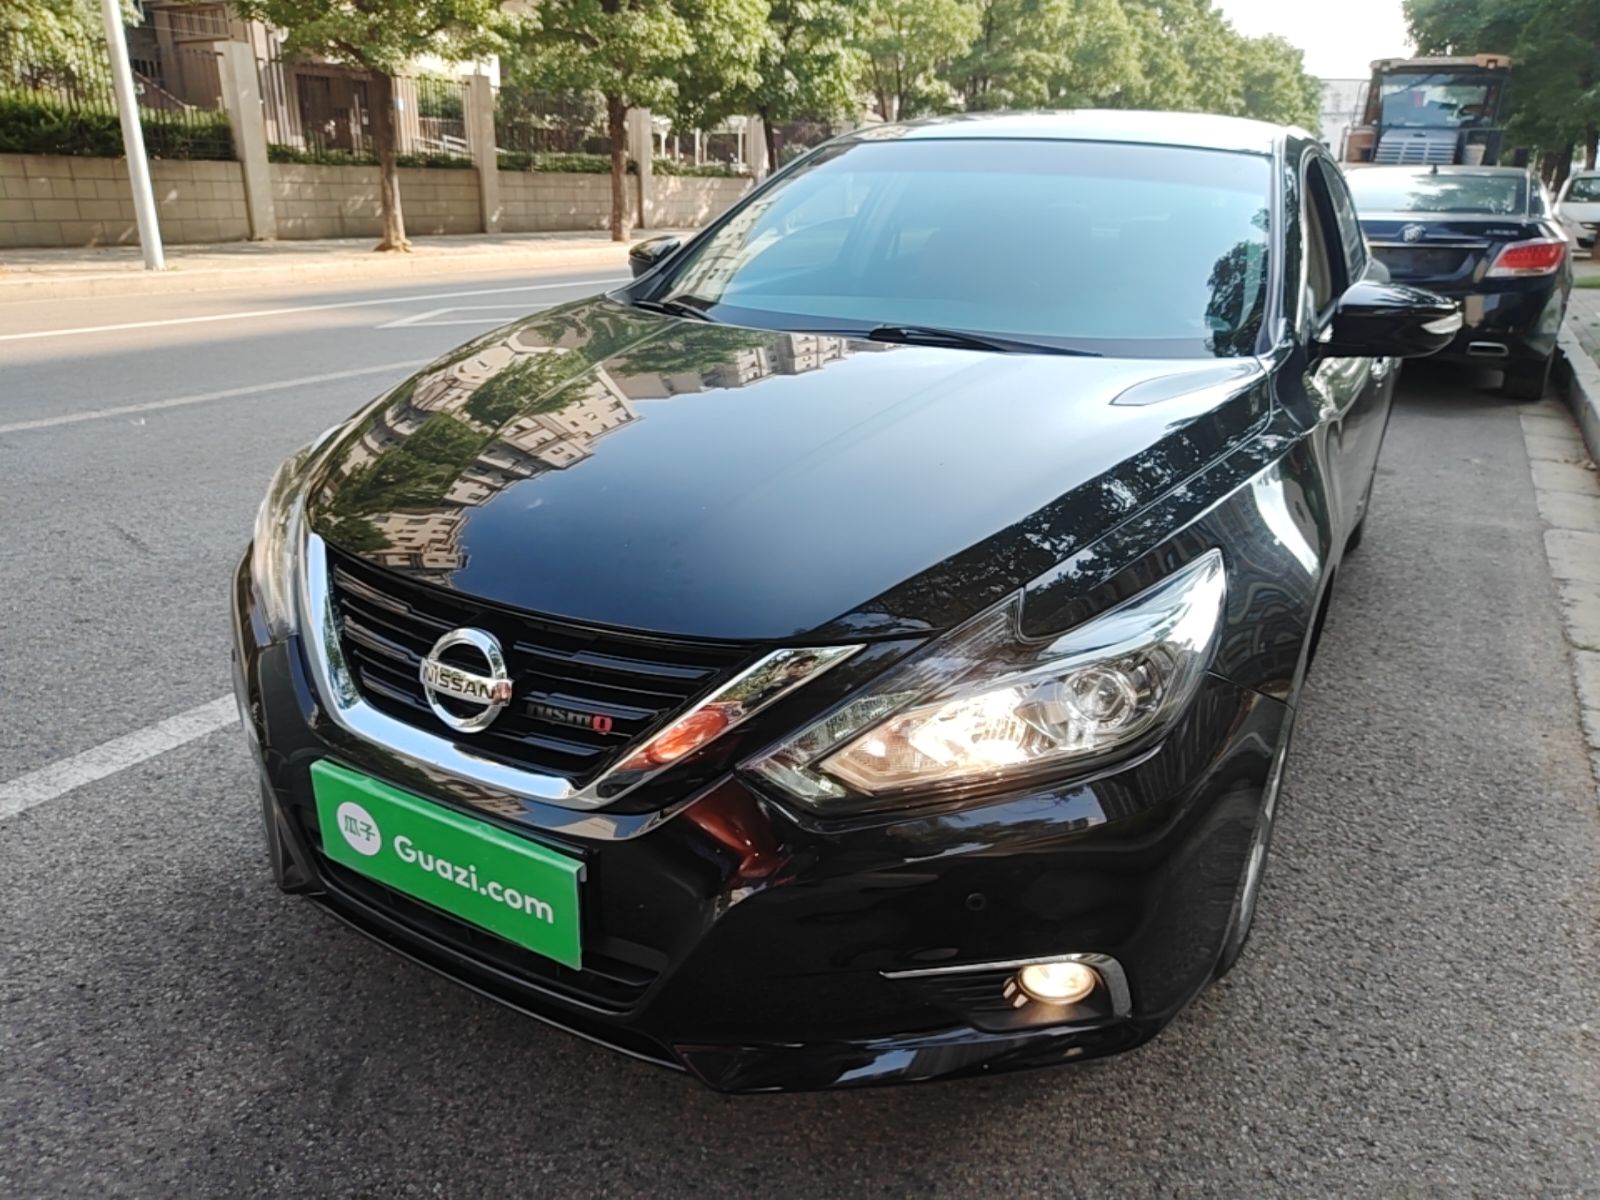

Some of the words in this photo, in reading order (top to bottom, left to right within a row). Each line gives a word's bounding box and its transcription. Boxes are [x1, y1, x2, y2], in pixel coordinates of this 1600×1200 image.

[424, 663, 493, 699] NISSAN
[344, 814, 375, 841] 瓜子
[394, 836, 554, 922] Guazi.com
